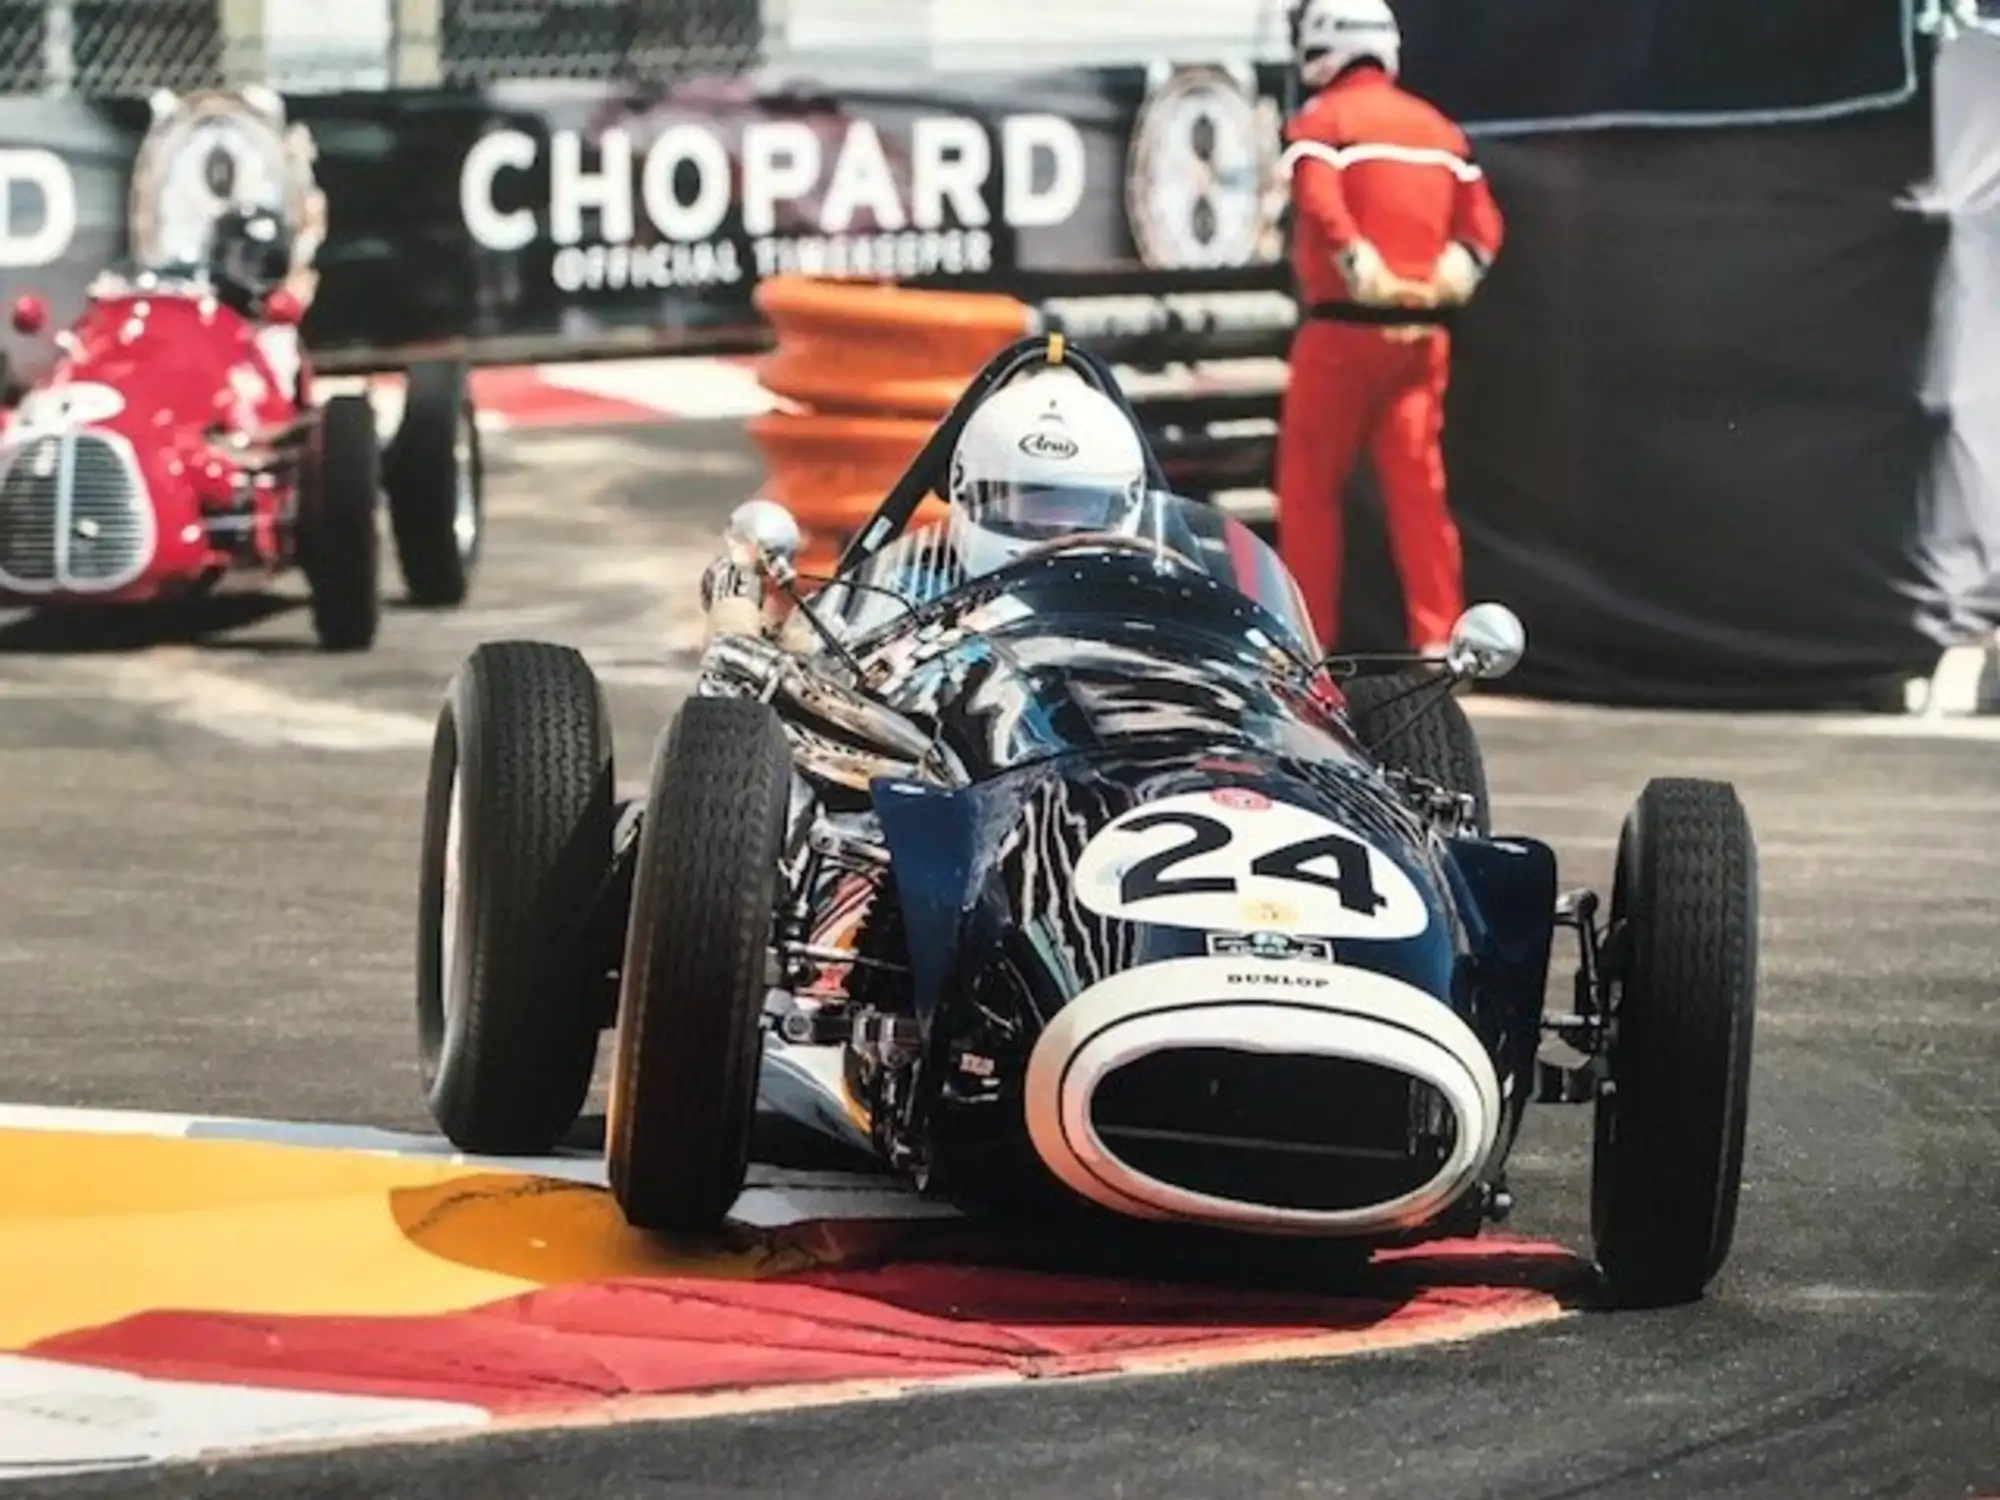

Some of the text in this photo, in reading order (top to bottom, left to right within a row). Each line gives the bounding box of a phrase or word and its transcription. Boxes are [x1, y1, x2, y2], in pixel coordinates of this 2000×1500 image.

[459, 112, 1086, 250] CHOPARD
[551, 238, 744, 293] OFFICIAL
[1113, 810, 1388, 918] 24
[1226, 972, 1330, 989] DUNLOP
